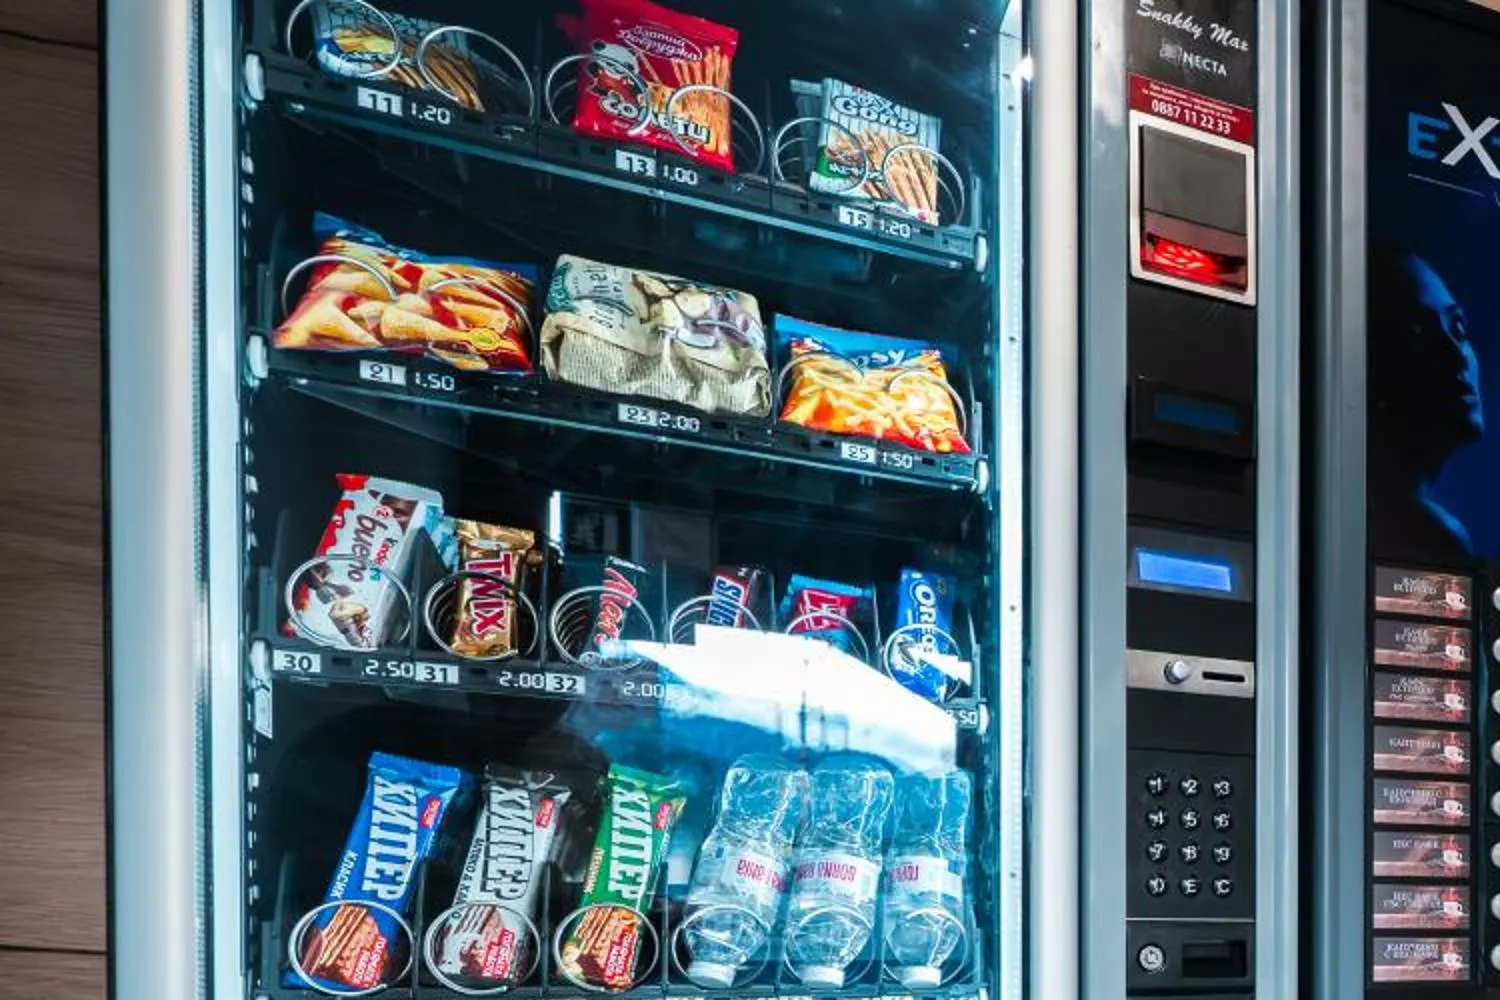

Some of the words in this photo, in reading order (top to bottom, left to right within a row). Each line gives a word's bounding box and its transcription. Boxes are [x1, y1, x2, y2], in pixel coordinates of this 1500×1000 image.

[1183, 51, 1228, 77] NECTA
[370, 94, 394, 115] 11
[411, 102, 451, 125] 1.20
[1184, 109, 1197, 123] 11
[1200, 115, 1213, 129] 22
[626, 156, 649, 174] 13
[663, 165, 699, 185] 1.00
[370, 363, 393, 381] 21
[415, 371, 455, 391] 1.50
[659, 411, 701, 432] 2.00
[466, 551, 512, 639] TWIX
[283, 654, 312, 671] 30
[365, 659, 414, 678] 2.50
[424, 666, 449, 682] 31
[499, 671, 545, 689] 2.00
[554, 674, 577, 691] 32
[362, 775, 419, 900] ХИПЕР
[483, 785, 534, 900] ХИПЕР
[607, 784, 653, 899] ХИПЕР
